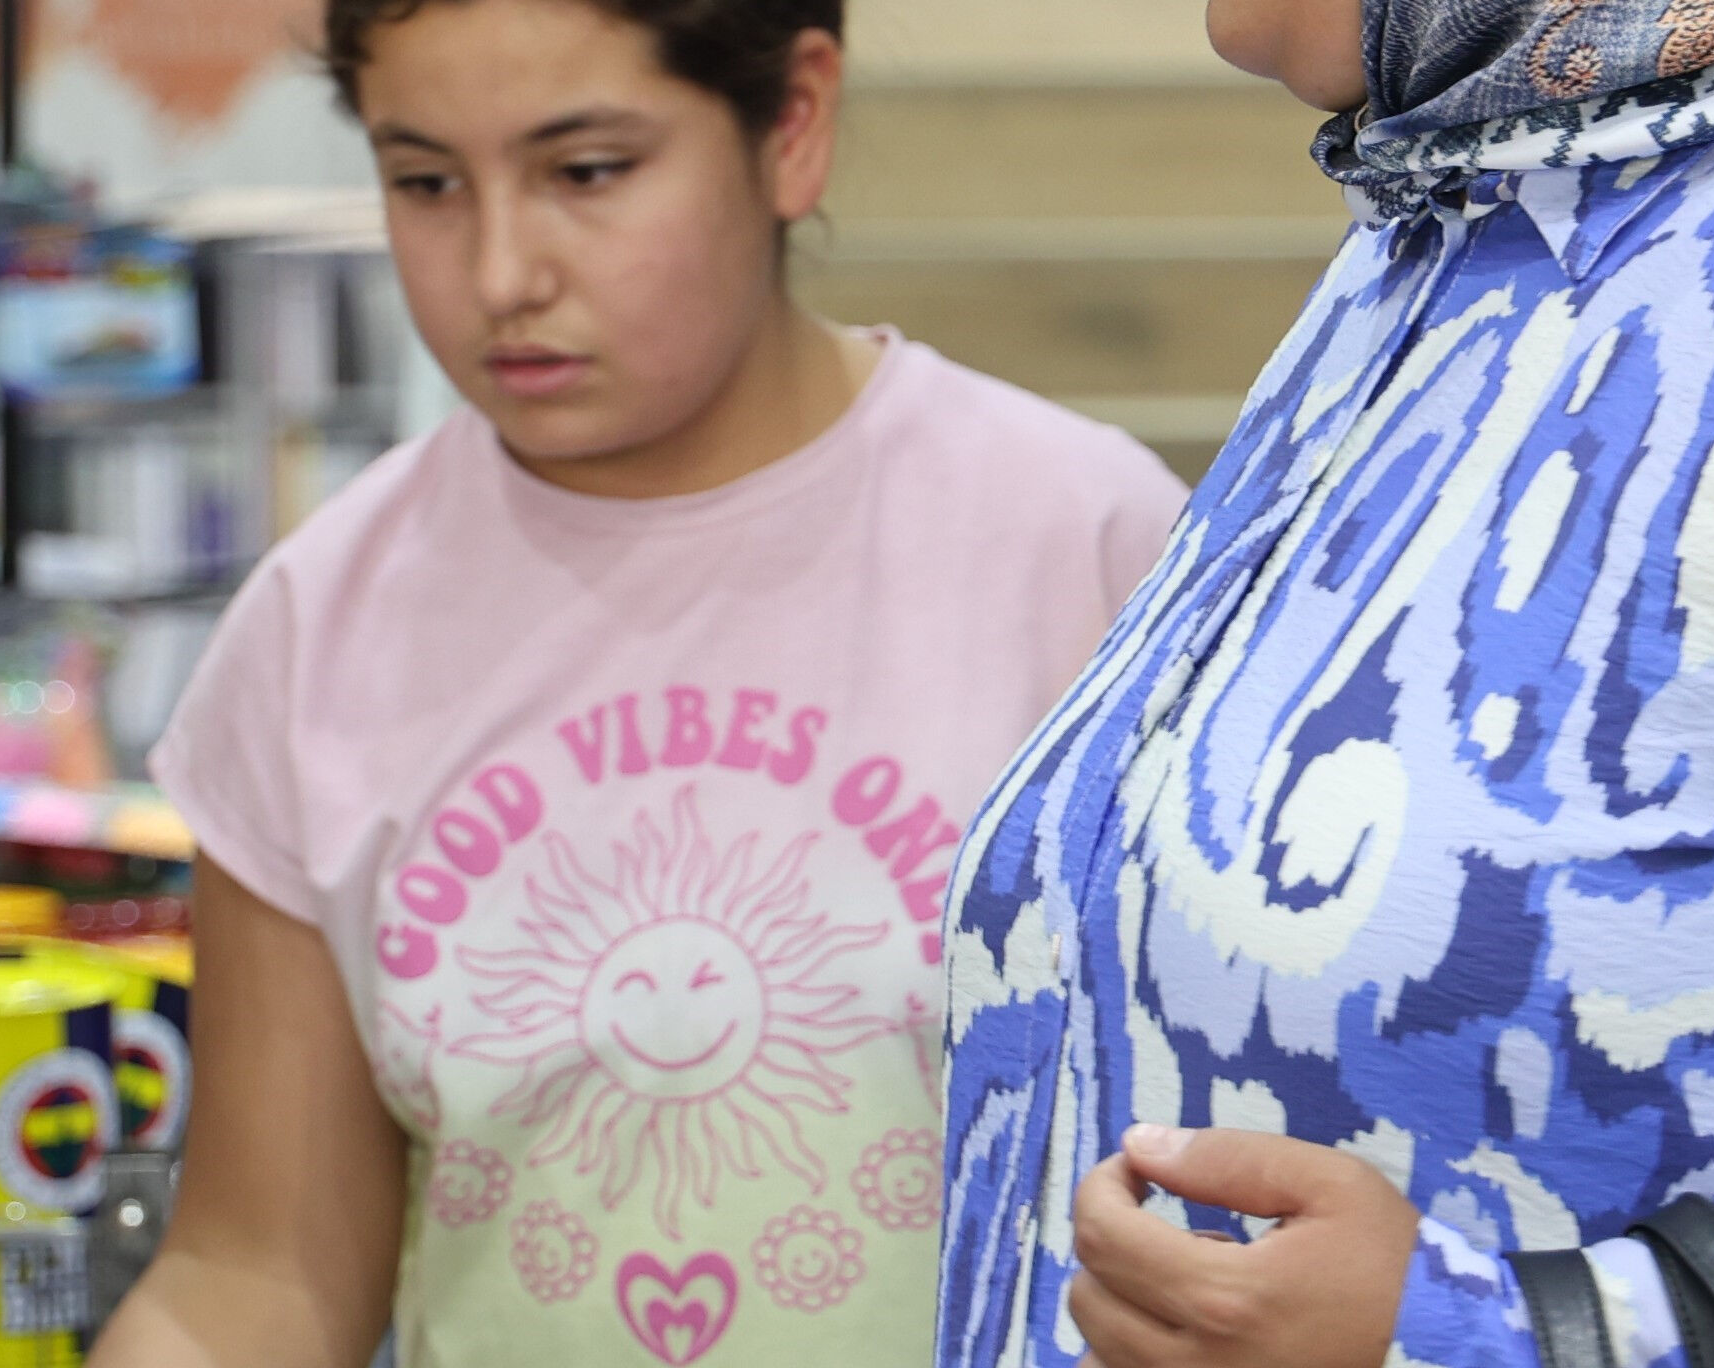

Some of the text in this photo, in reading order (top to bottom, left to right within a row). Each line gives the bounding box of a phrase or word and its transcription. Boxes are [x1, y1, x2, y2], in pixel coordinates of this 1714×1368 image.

[376, 684, 963, 982] GOOD VIBES ONL
